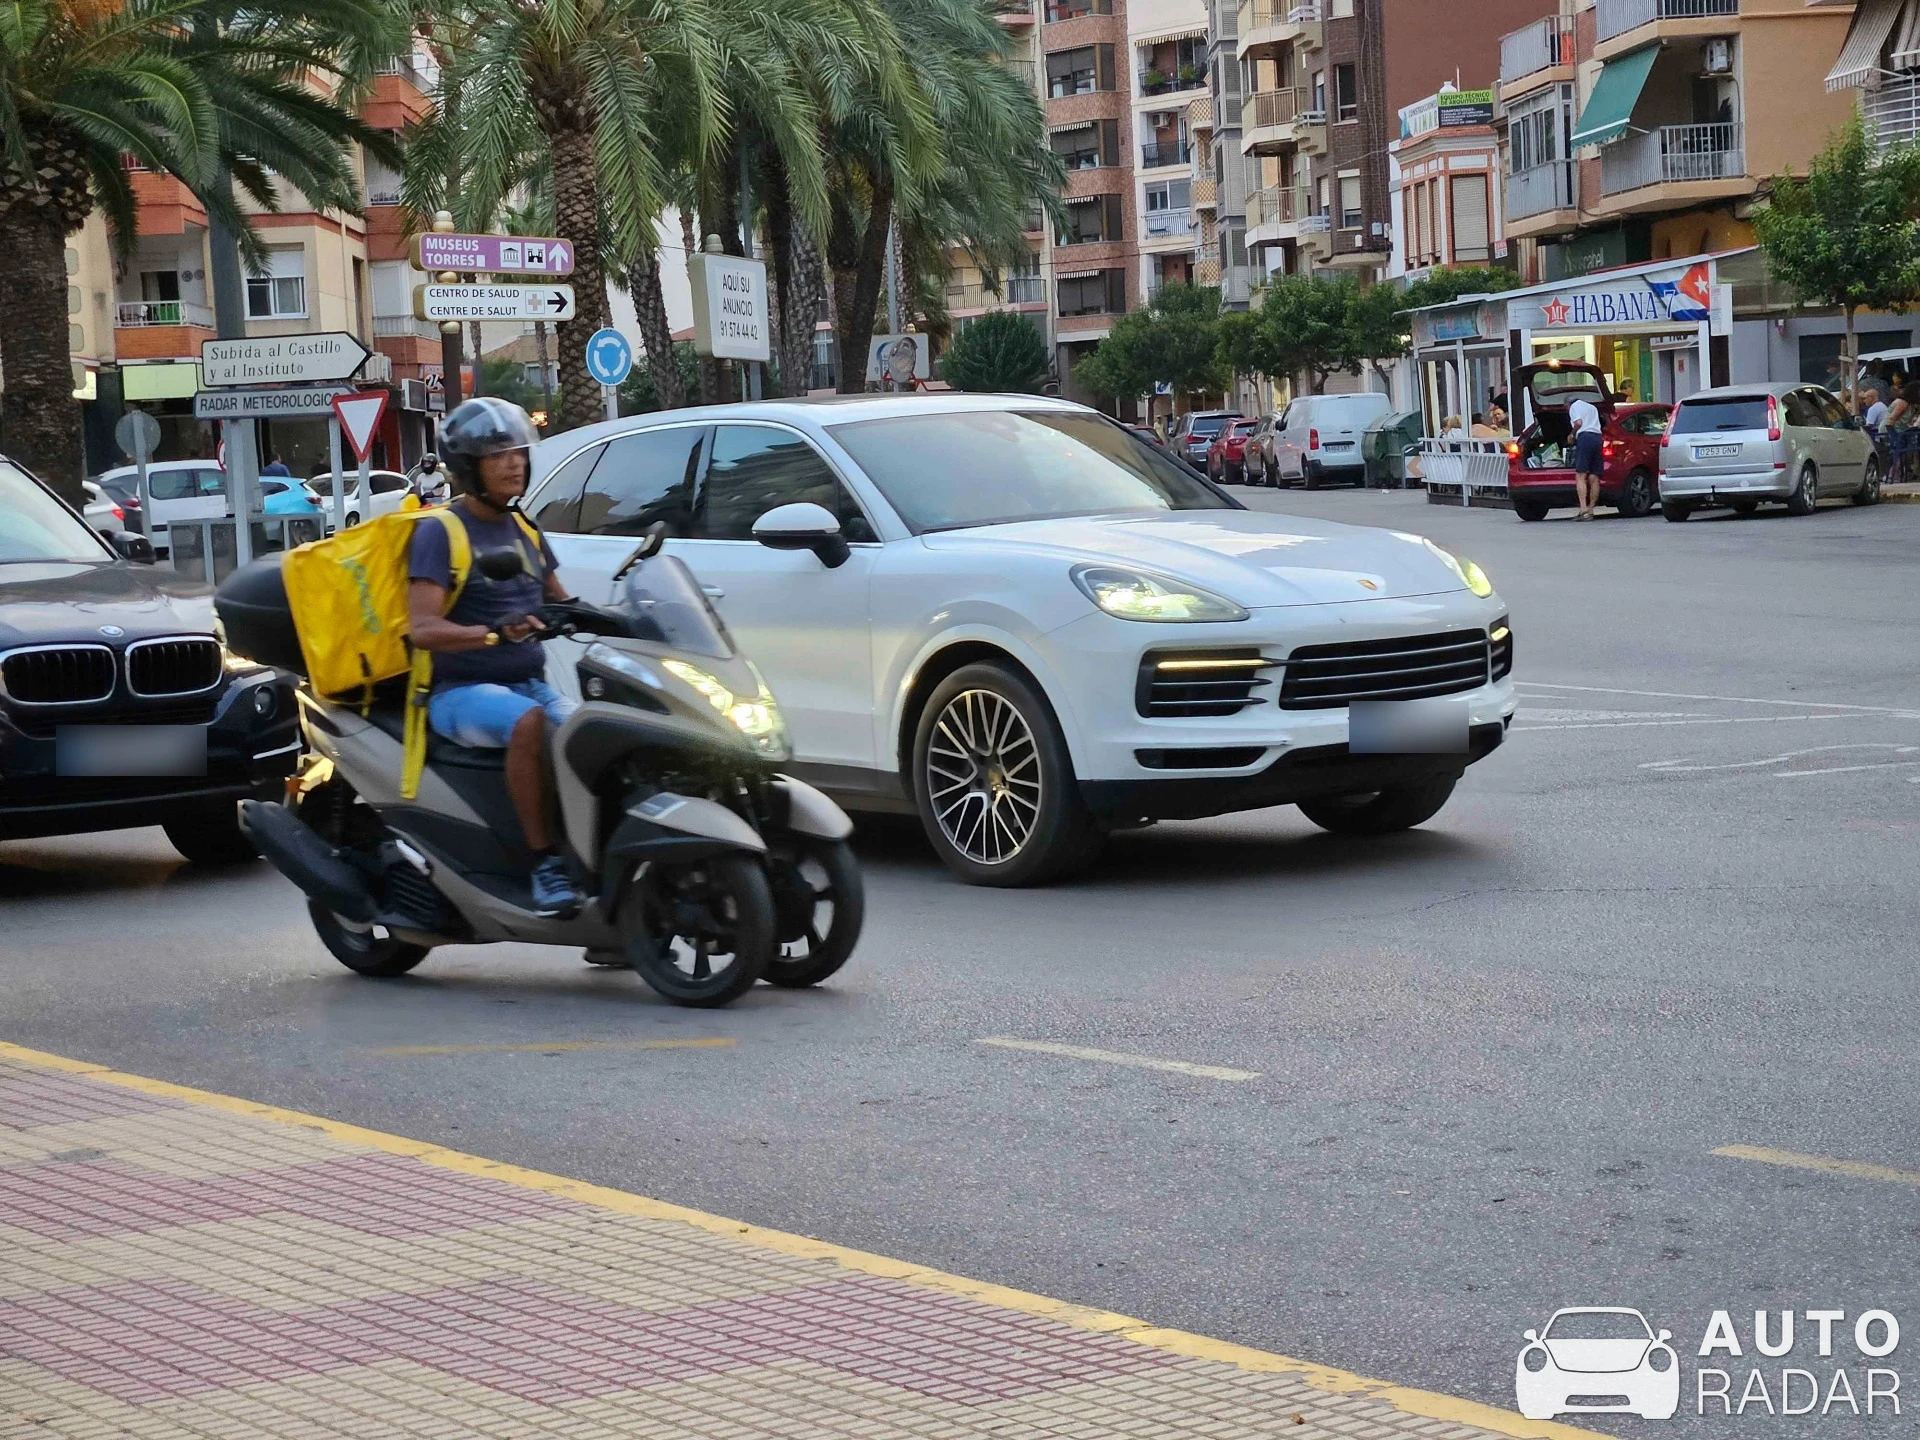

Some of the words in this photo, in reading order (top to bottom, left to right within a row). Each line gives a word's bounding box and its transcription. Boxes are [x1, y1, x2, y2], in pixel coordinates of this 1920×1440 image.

[1440, 93, 1463, 102] EQUIPO
[1465, 91, 1489, 100] TÉCNICO
[1449, 97, 1490, 105] ARQUITECTURA
[426, 238, 479, 251] MUSEUS
[426, 253, 475, 266] TORRES
[722, 271, 740, 292] AQUÍ
[740, 276, 750, 293] SU
[429, 288, 469, 299] CENTRO
[472, 288, 485, 299] DE
[488, 289, 520, 299] SALUD
[430, 306, 468, 316] CENTRE
[471, 306, 484, 316] DE
[487, 306, 517, 316] SALUT
[722, 297, 753, 317] ANUNCIO
[1551, 305, 1565, 321] MI
[1573, 292, 1659, 323] HABANA
[1663, 290, 1675, 319] 7
[720, 320, 728, 337] 91
[729, 322, 741, 338] 574
[741, 324, 750, 339] 44
[750, 325, 758, 340] 42
[210, 346, 261, 361] Subida
[268, 344, 281, 357] al
[288, 340, 341, 356] Castillo
[209, 368, 217, 382] y
[223, 365, 236, 378] al
[243, 362, 304, 377] Instituto
[200, 396, 238, 411] RADAR
[1700, 448, 1719, 456] 0253
[1722, 446, 1737, 454] GNM
